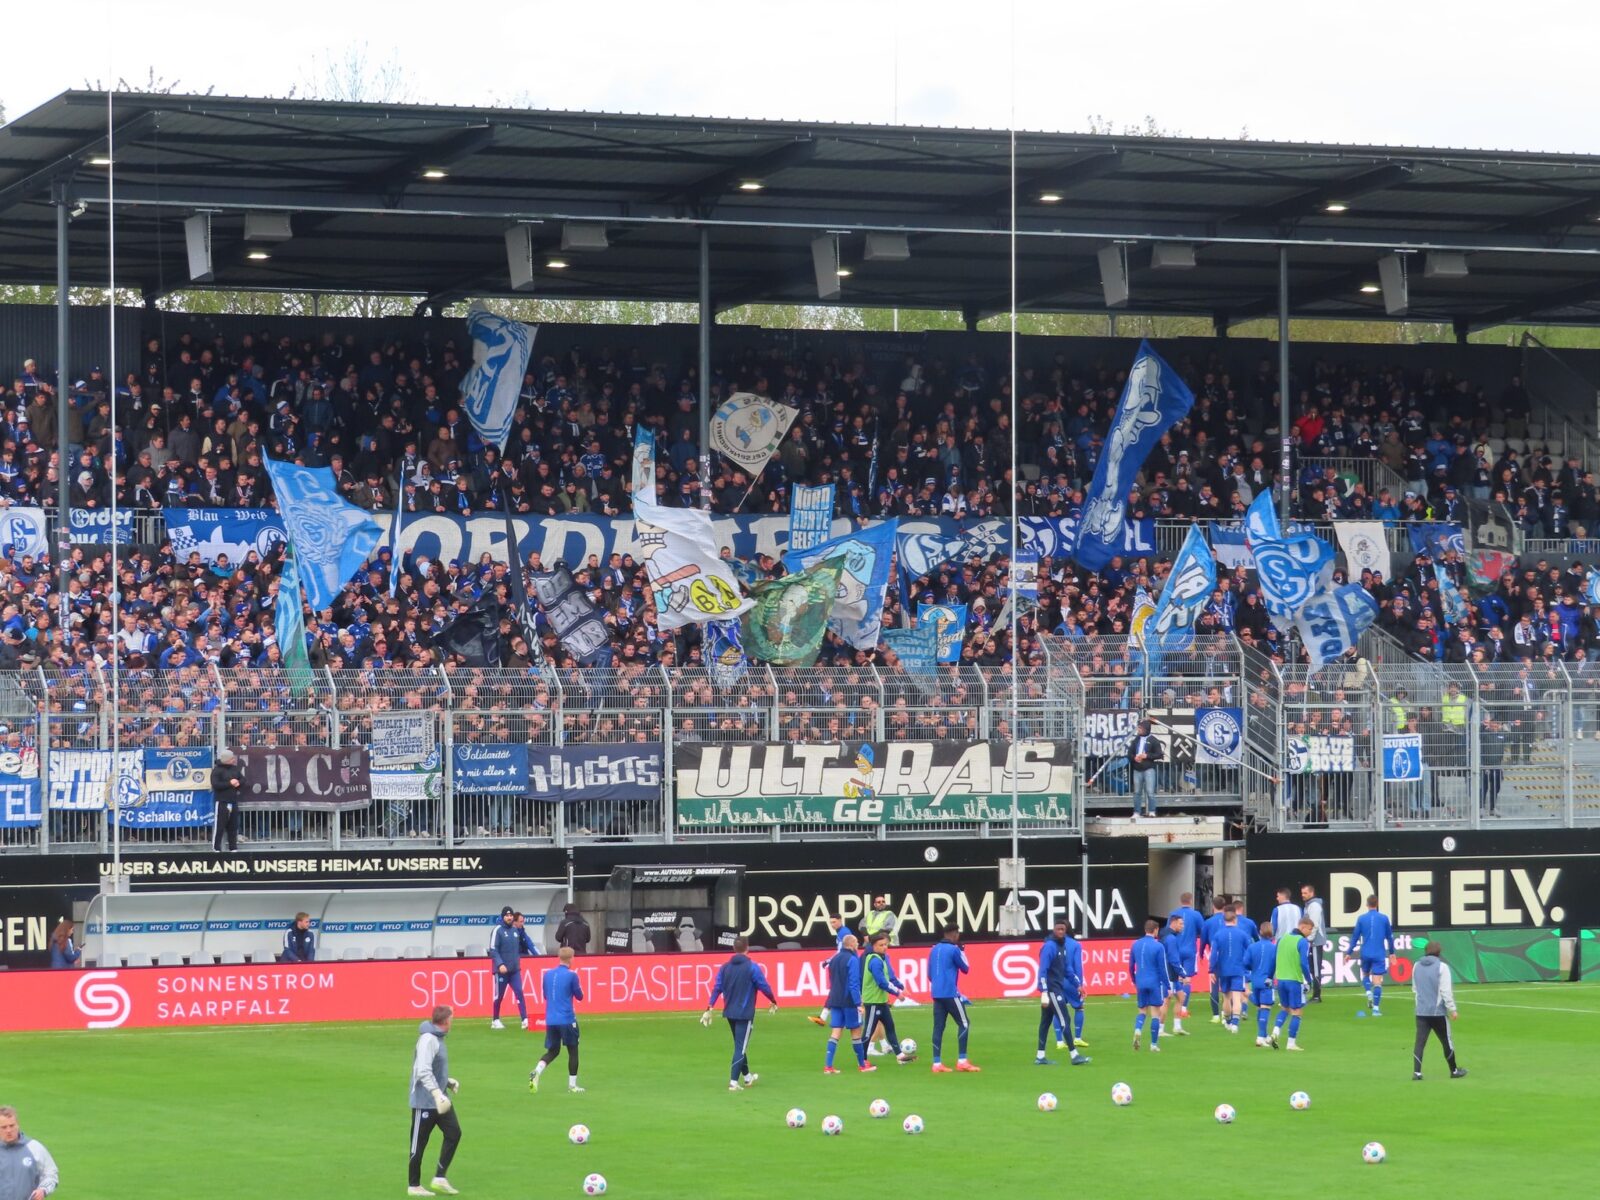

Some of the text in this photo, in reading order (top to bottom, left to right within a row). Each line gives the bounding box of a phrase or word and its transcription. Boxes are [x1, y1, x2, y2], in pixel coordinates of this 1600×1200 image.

[187, 508, 219, 522] Blau
[1311, 736, 1354, 754] BLUE
[49, 781, 106, 809] CLUB
[137, 810, 182, 822] Schalke
[185, 810, 199, 821] 04
[158, 860, 250, 873] SAARLAND.
[254, 859, 317, 872] UNSERE
[321, 857, 384, 872] HEIMAT.
[387, 856, 448, 871] UNSERE
[453, 856, 483, 871] ELV.
[1329, 868, 1564, 928] DIE ELV.
[157, 973, 335, 994] SONNENSTROM
[157, 999, 290, 1019] SAARPFALZ
